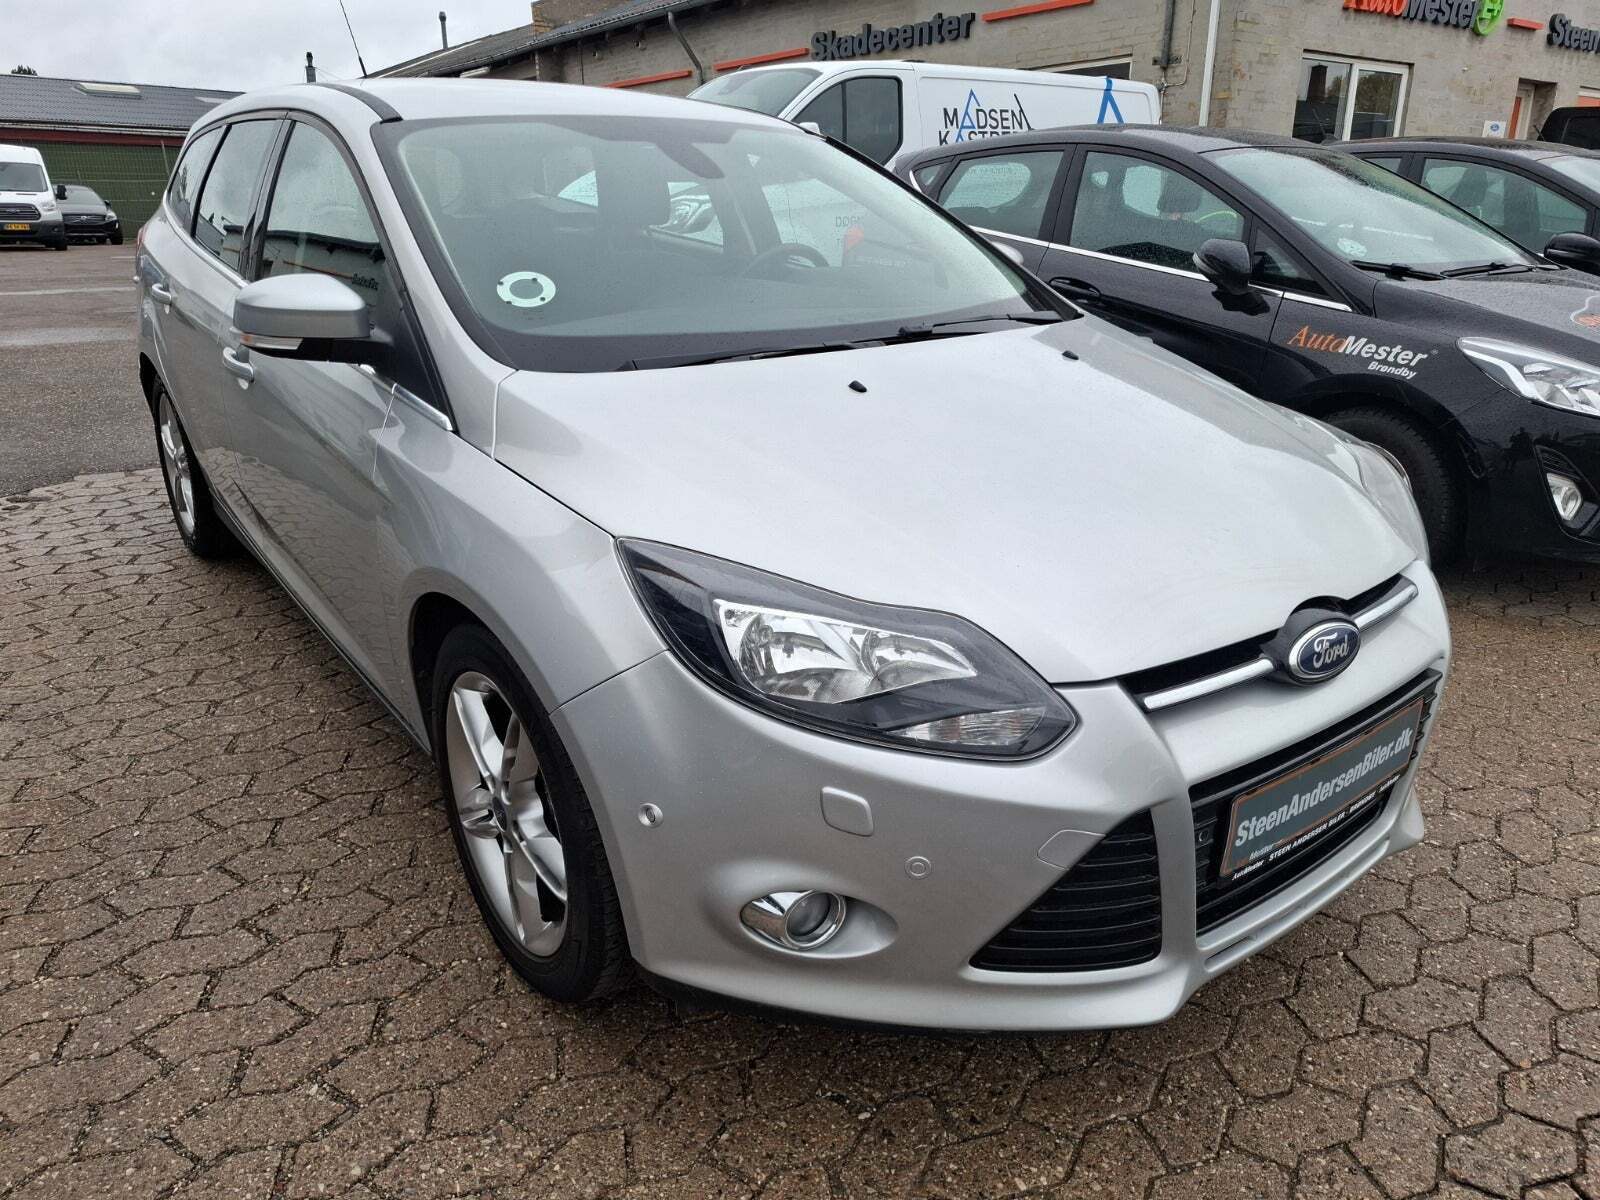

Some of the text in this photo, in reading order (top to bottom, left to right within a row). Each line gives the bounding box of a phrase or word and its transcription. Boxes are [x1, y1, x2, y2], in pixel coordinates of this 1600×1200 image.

[810, 12, 976, 61] Skadecenter
[1547, 12, 1600, 54] Steen
[943, 88, 1032, 131] MADSEN
[1287, 325, 1428, 367] AutoMester
[1313, 632, 1350, 669] Ford
[1235, 727, 1413, 847] SteenAndersenBiler.dk
[1269, 843, 1292, 862] STEEN
[1292, 822, 1328, 848] ANDERSEN
[1328, 811, 1346, 828] BILER
